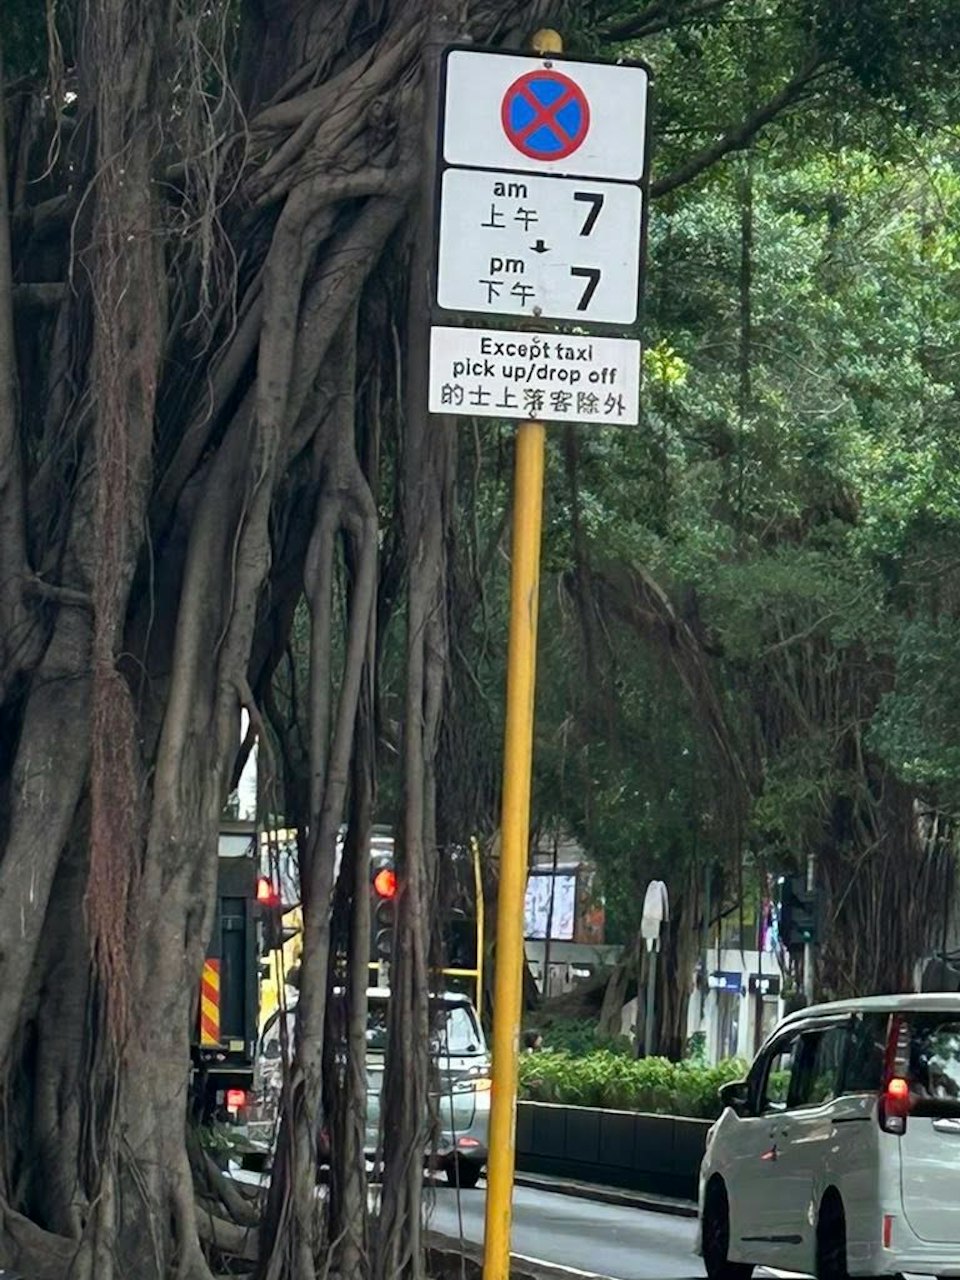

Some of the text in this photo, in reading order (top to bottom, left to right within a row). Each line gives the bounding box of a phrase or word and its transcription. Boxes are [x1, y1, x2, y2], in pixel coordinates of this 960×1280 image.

[493, 181, 528, 199] am
[480, 203, 539, 232] 上午
[573, 191, 605, 237] 7
[490, 256, 525, 276] pm
[478, 279, 536, 307] 下午
[570, 266, 601, 312] 7
[480, 336, 593, 361] Except taxi
[452, 357, 618, 385] pick up/drop off
[440, 382, 627, 416] 的士上落客除外
